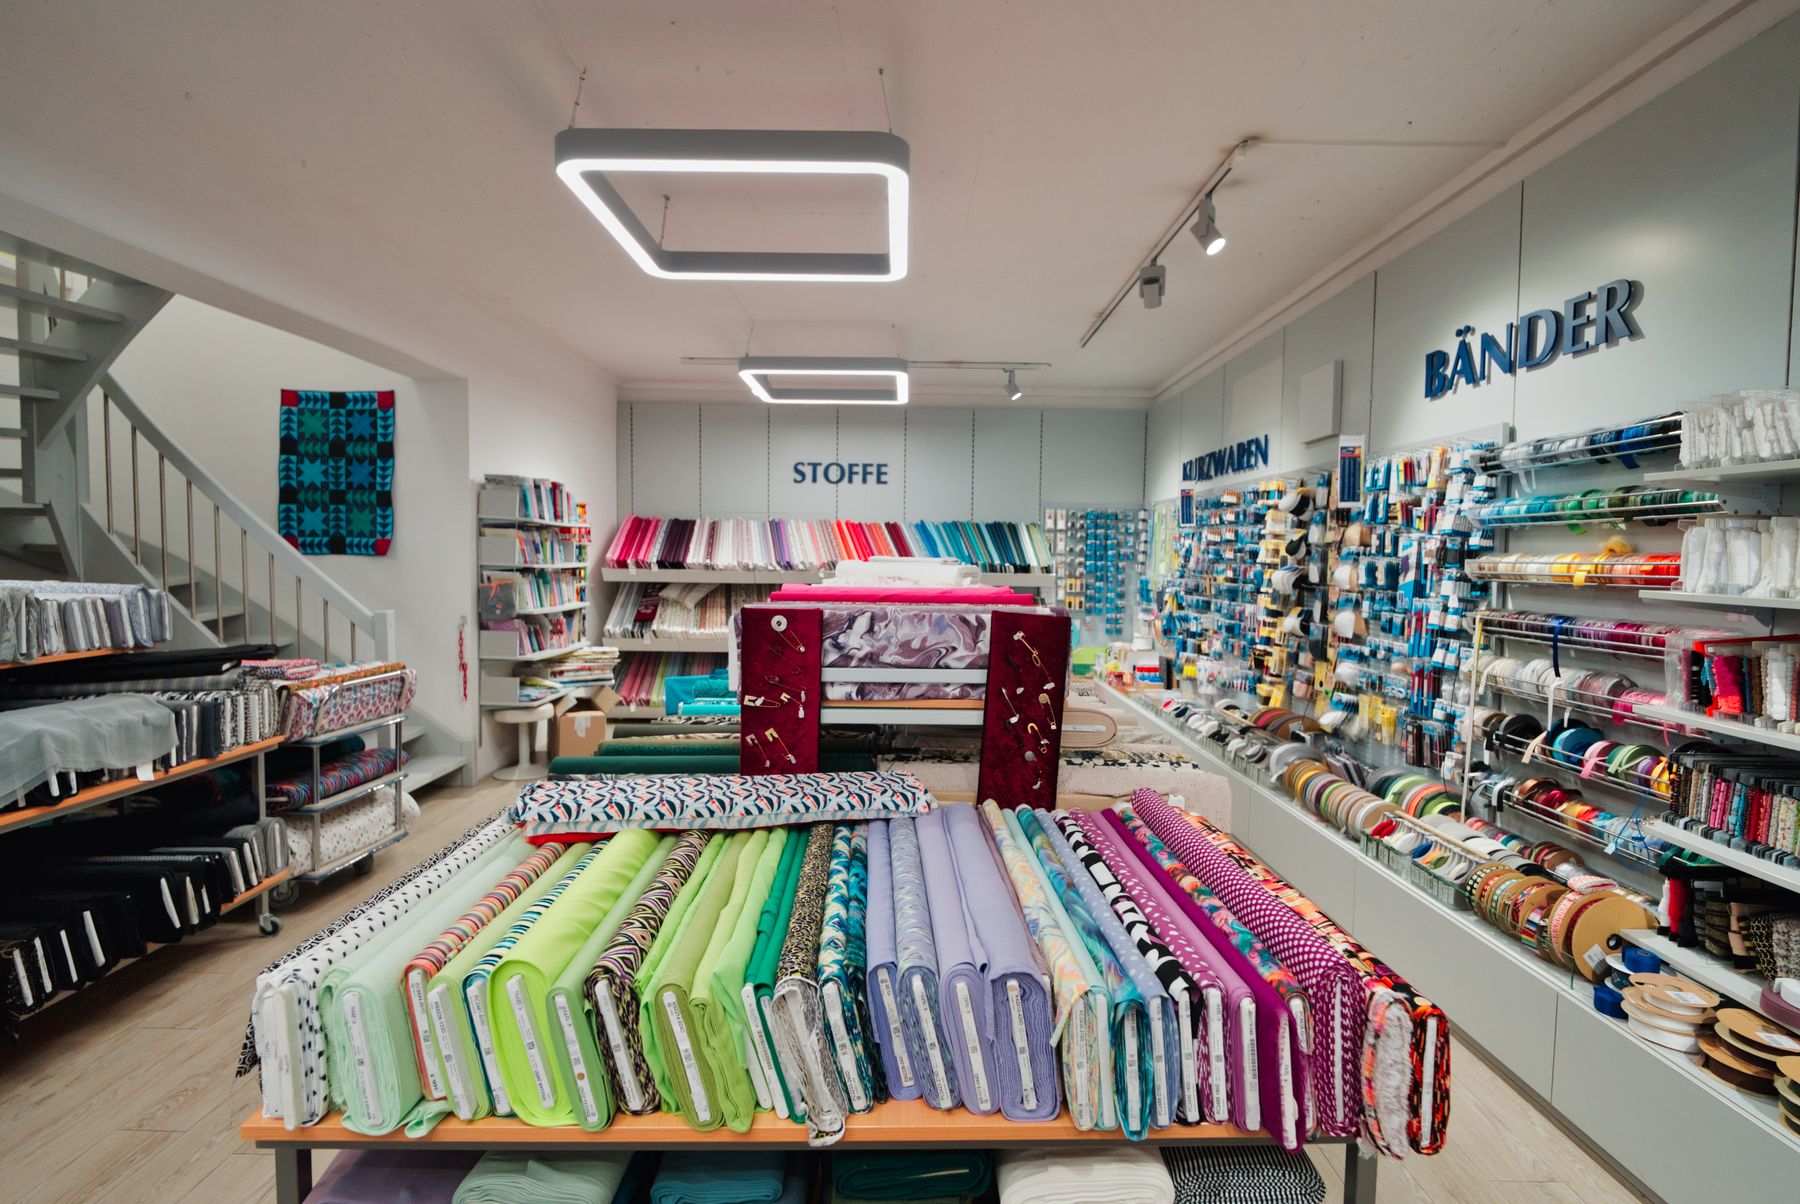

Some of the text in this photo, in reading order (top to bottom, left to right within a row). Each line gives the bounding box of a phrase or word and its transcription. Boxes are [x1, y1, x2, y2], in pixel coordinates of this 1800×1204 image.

[1424, 279, 1634, 398] BÄNDER
[793, 462, 888, 485] STOFFE
[1182, 434, 1269, 482] KURZWAREN
